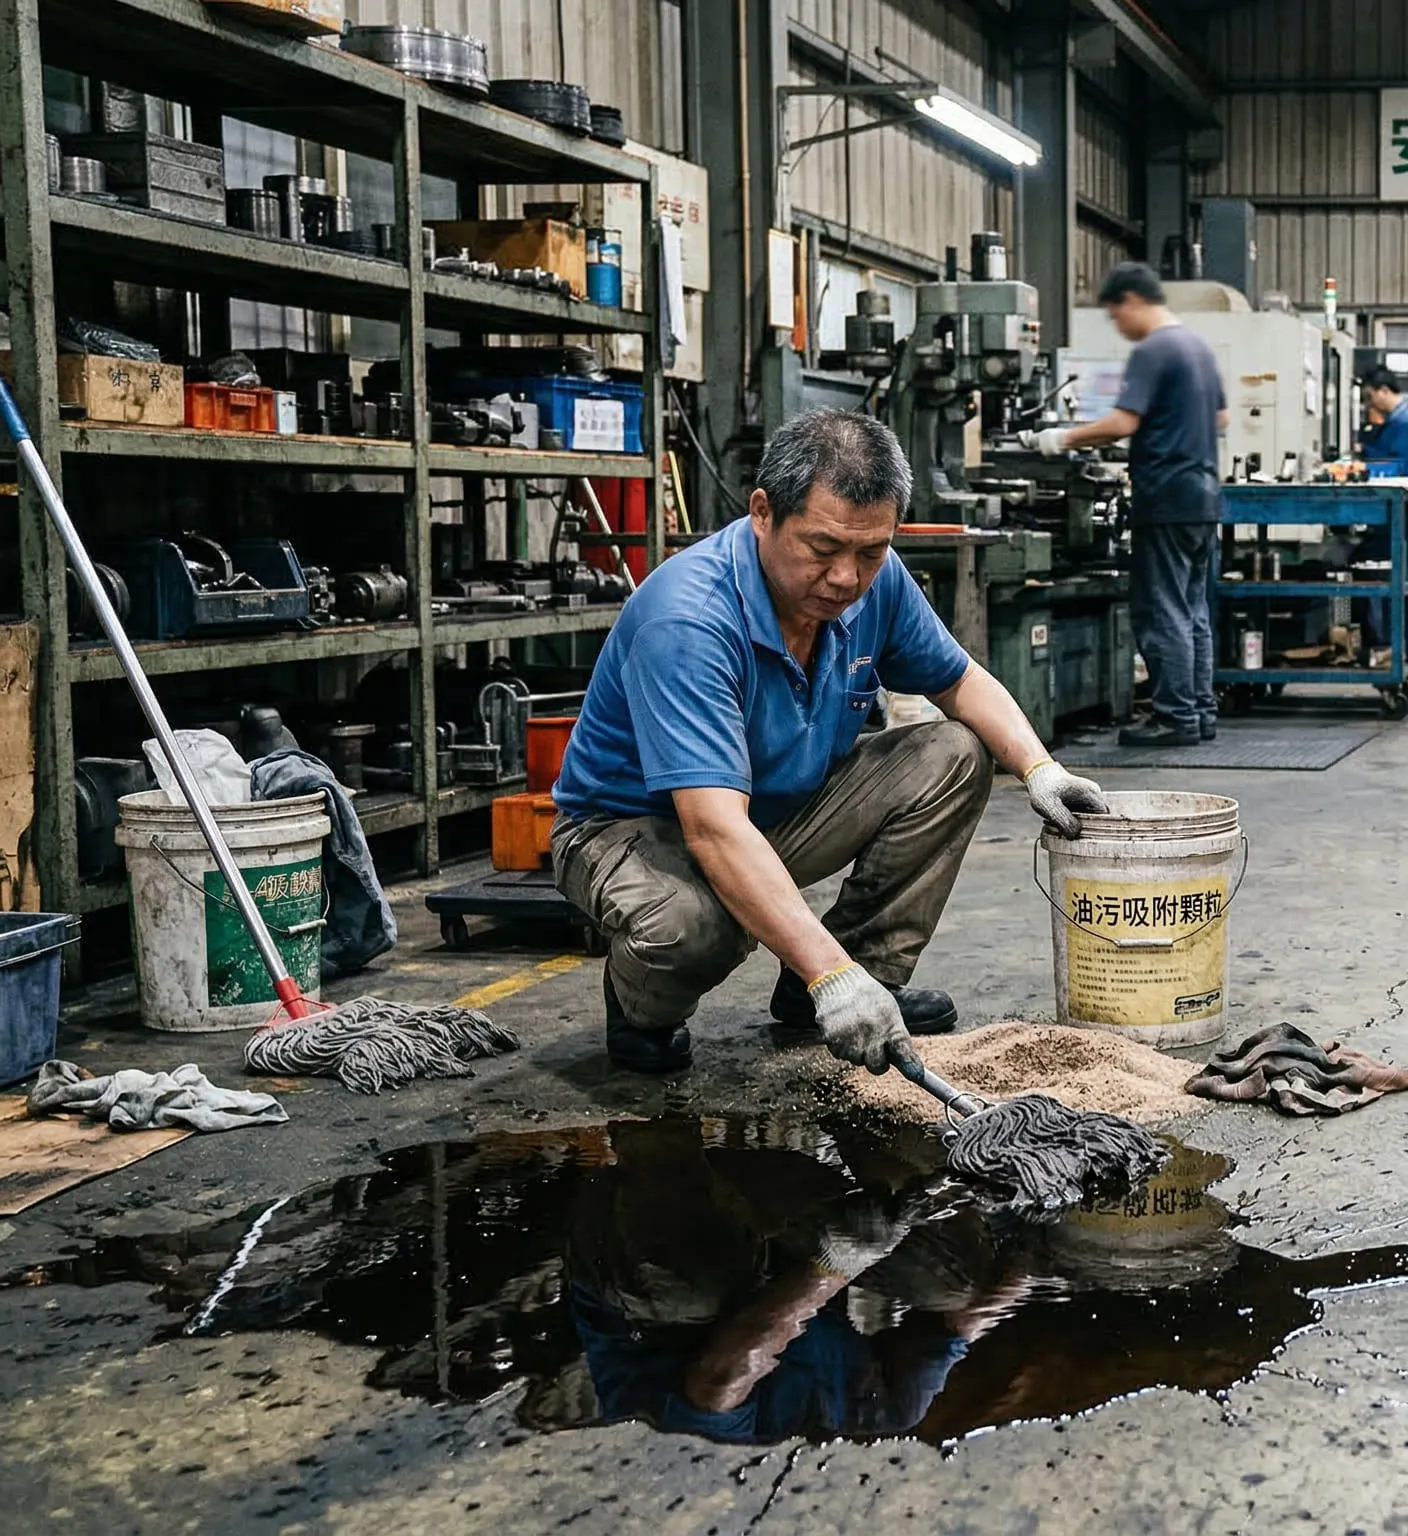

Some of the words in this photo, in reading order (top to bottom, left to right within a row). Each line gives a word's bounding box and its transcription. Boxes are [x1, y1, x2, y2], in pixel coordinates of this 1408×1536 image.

[1072, 889, 1222, 927] 油污吸附顆粒
